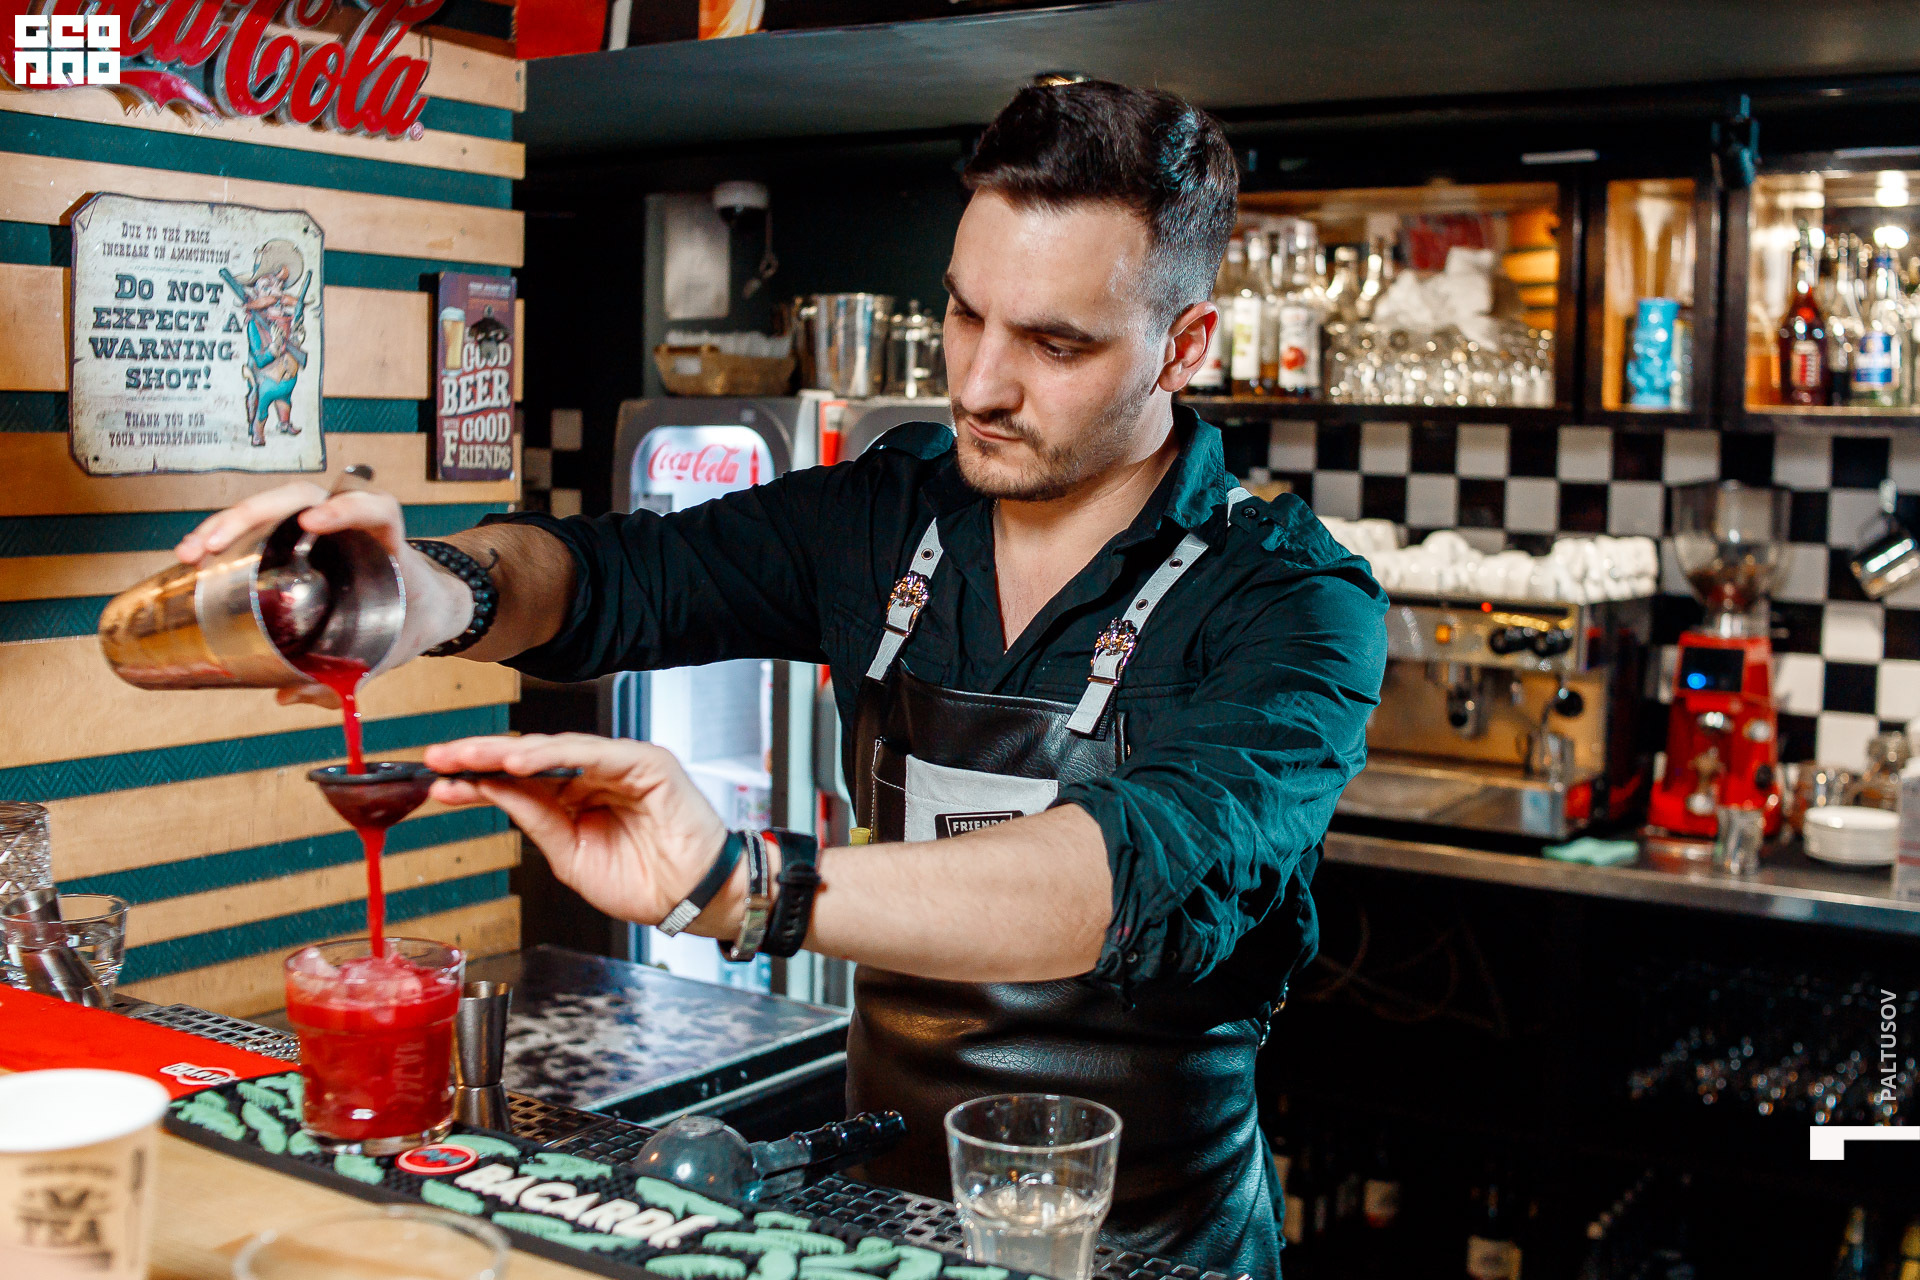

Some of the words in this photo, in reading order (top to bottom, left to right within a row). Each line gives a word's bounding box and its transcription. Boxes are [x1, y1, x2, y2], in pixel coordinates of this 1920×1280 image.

[146, 227, 157, 240] TO
[163, 227, 181, 243] THE
[184, 229, 210, 244] PRICE
[102, 242, 149, 257] INCREASE
[154, 246, 165, 258] ON
[170, 247, 230, 264] AMMUNITION
[115, 273, 154, 300] DO
[167, 280, 224, 304] NOT
[93, 307, 209, 332] EXPECT
[222, 313, 243, 333] A
[89, 337, 234, 361] WARNING
[125, 365, 211, 390] SHOT!
[440, 369, 511, 416] BEER
[125, 411, 160, 428] THANK
[165, 413, 183, 427] YOU
[188, 413, 205, 427] FOR
[461, 412, 511, 443] GOOD
[109, 431, 135, 447] YOUR
[442, 430, 512, 470] FRIENDS
[952, 820, 1007, 832] FRIEN
